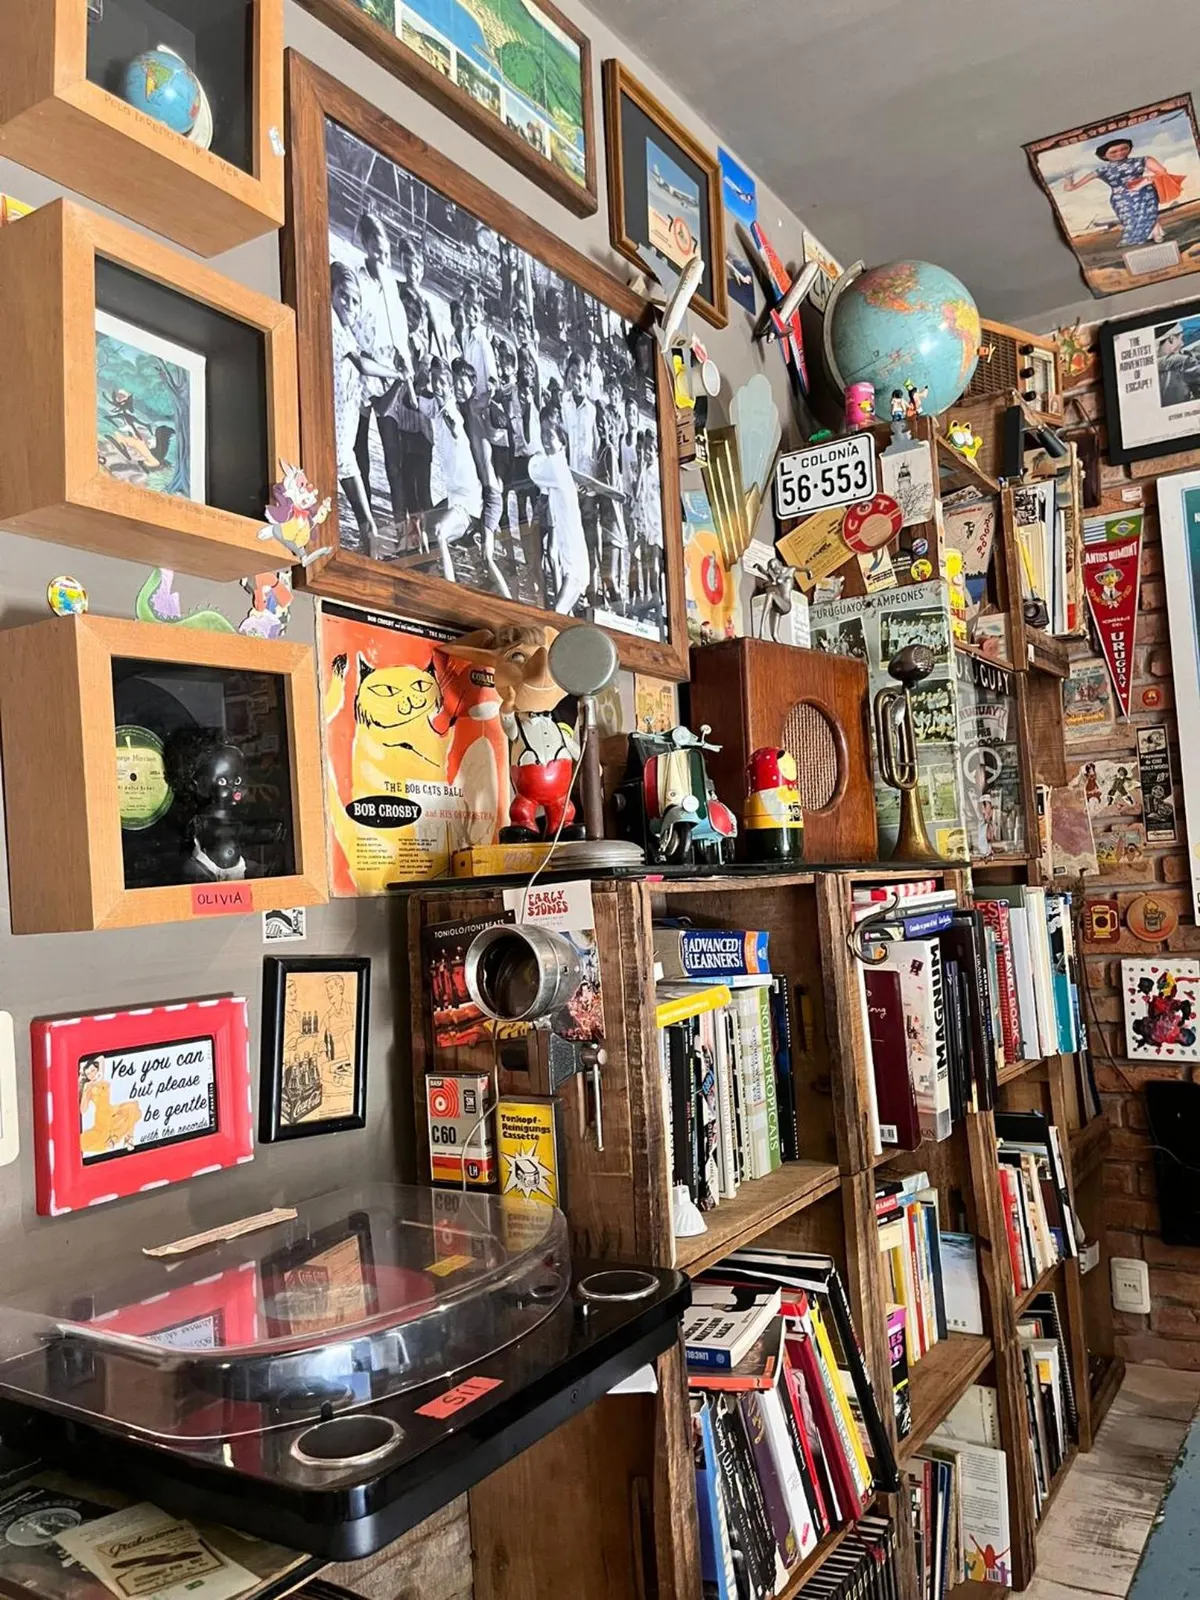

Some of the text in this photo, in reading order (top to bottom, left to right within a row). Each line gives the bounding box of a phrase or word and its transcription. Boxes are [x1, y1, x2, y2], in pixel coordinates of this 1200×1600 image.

[1129, 336, 1140, 347] THE
[1121, 344, 1152, 361] GREATEST
[1120, 355, 1155, 372] ADVENTURE
[780, 462, 792, 477] L
[1085, 541, 1138, 565] ANTOS DUMONT
[1110, 631, 1127, 688] URUGUAY
[384, 781, 464, 798] THE BOB CATS BALL
[353, 802, 419, 819] BOB CROSBY
[425, 810, 436, 818] and
[439, 810, 452, 818] HIS
[197, 891, 243, 905] OLIVIA
[528, 889, 565, 906] EARLY
[528, 901, 568, 917] STONES
[688, 938, 739, 953] ADVANCED
[689, 953, 741, 969] LEARNER'S
[1004, 944, 1015, 998] TRAVEL
[928, 944, 948, 1071] MAGNUM
[1008, 999, 1020, 1041] BOOK
[111, 1050, 204, 1083] Yes you can
[129, 1075, 200, 1099] but please
[144, 1094, 208, 1126] be gentle
[140, 1117, 208, 1143] with the records
[503, 1131, 540, 1141] Cassette
[468, 1165, 478, 1177] LH
